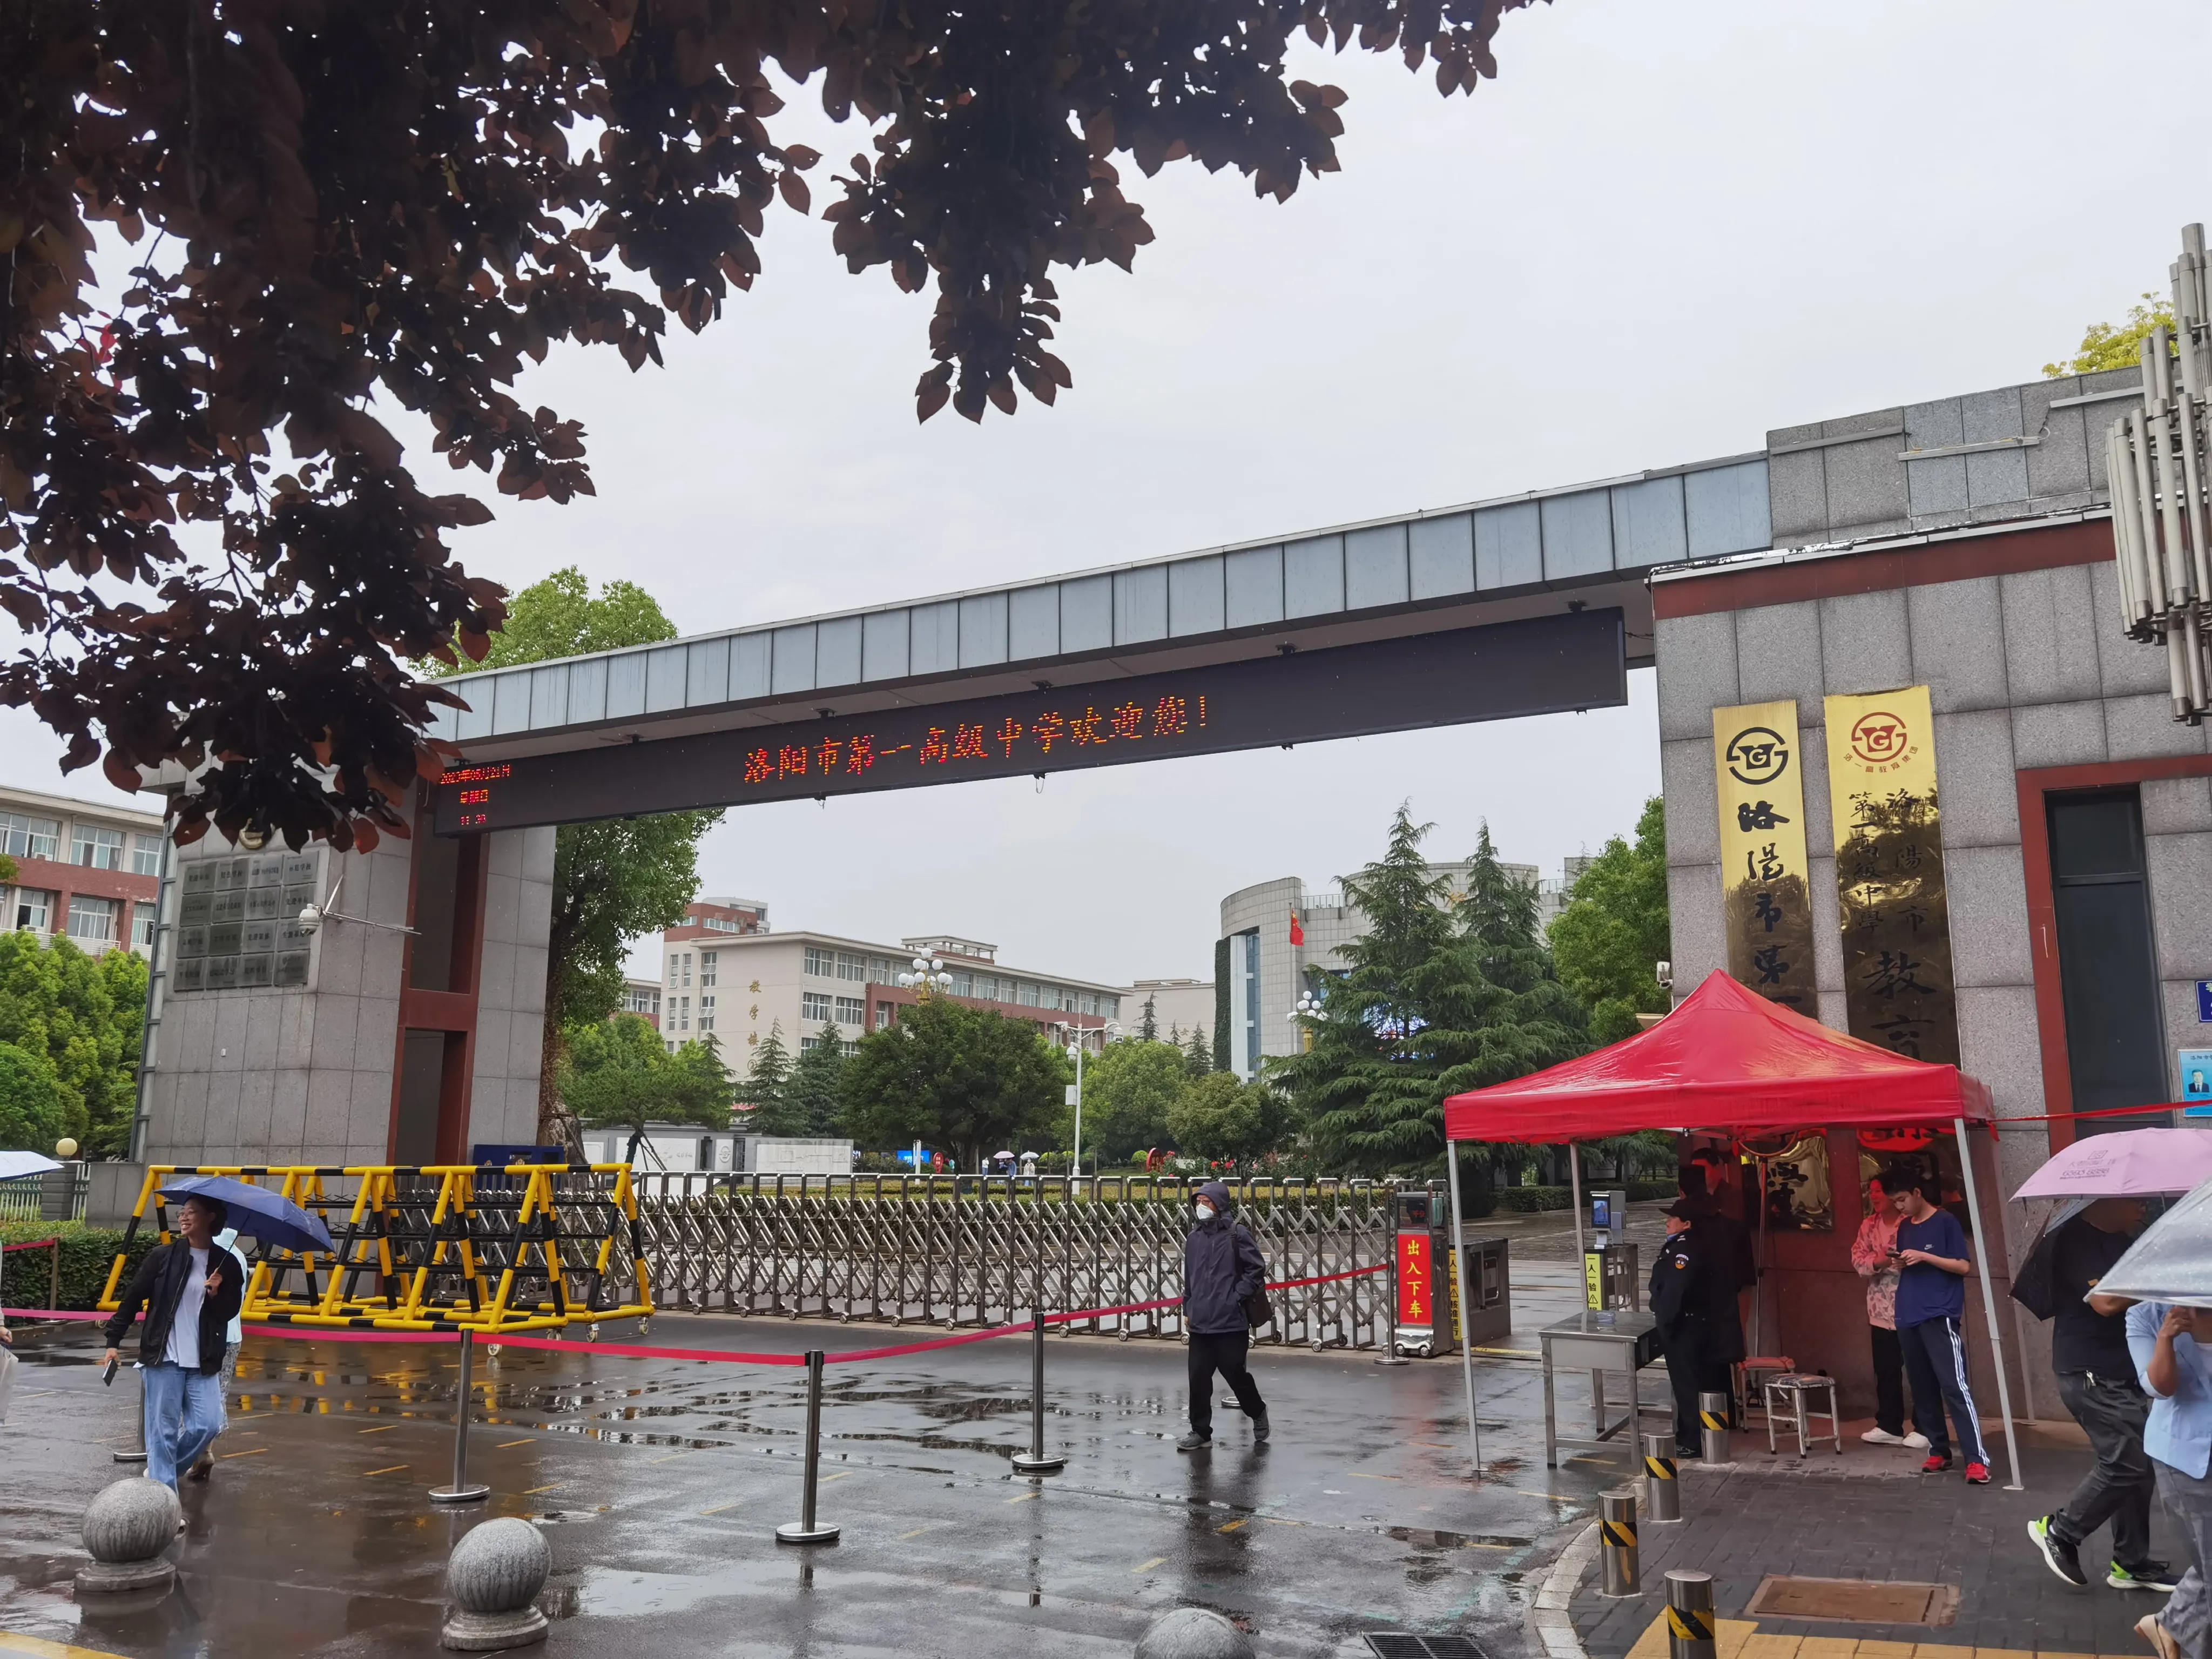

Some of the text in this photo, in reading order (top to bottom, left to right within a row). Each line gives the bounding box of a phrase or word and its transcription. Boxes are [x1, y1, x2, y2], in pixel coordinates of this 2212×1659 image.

[1406, 1239, 1423, 1319] 出入下车
[1587, 1257, 1597, 1292] 一人一验
